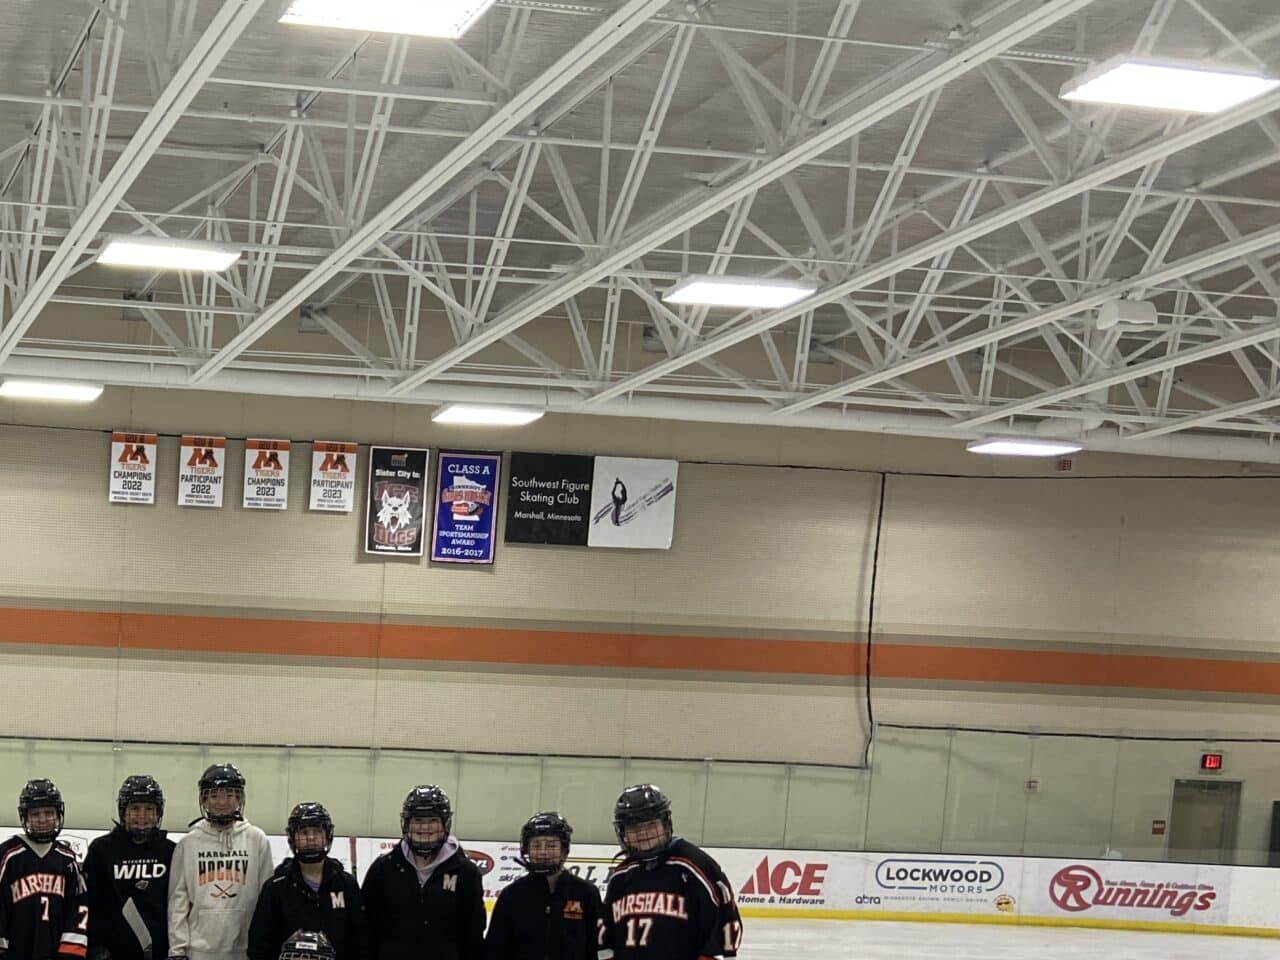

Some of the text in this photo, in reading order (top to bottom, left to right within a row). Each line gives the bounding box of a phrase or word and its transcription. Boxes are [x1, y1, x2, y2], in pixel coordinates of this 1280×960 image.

[375, 469, 396, 478] Sister
[397, 470, 412, 479] City
[448, 463, 490, 475] CLASS A
[113, 471, 152, 481] CHAMPIONS
[181, 474, 222, 485] PARTICIPANT
[122, 481, 142, 491] 2022
[247, 478, 285, 487] CHAMPIONS
[312, 479, 353, 490] PARTICIPANT
[512, 476, 590, 493] Southwest Figure
[190, 484, 211, 494] 2022
[256, 487, 276, 497] 2023
[322, 489, 342, 499] 2023
[520, 491, 580, 506] Skating Club
[547, 513, 582, 522] Minnesota
[439, 530, 489, 539] SPORTSMANSHIP
[451, 538, 476, 546] AWARD
[441, 547, 483, 557] 2016-2017
[113, 863, 167, 880] WILD
[198, 859, 249, 887] HOCKEY
[739, 854, 829, 896] ACE
[886, 867, 992, 883] LOCKWOOD
[442, 873, 458, 893] M
[929, 885, 983, 894] MOTORS
[1050, 865, 1217, 917] Runnings
[330, 891, 346, 910] M
[738, 895, 825, 905] Home & Hardware
[855, 895, 881, 905] abra
[40, 896, 50, 922] 7
[611, 891, 689, 924] MARSHALL
[625, 917, 653, 947] 17
